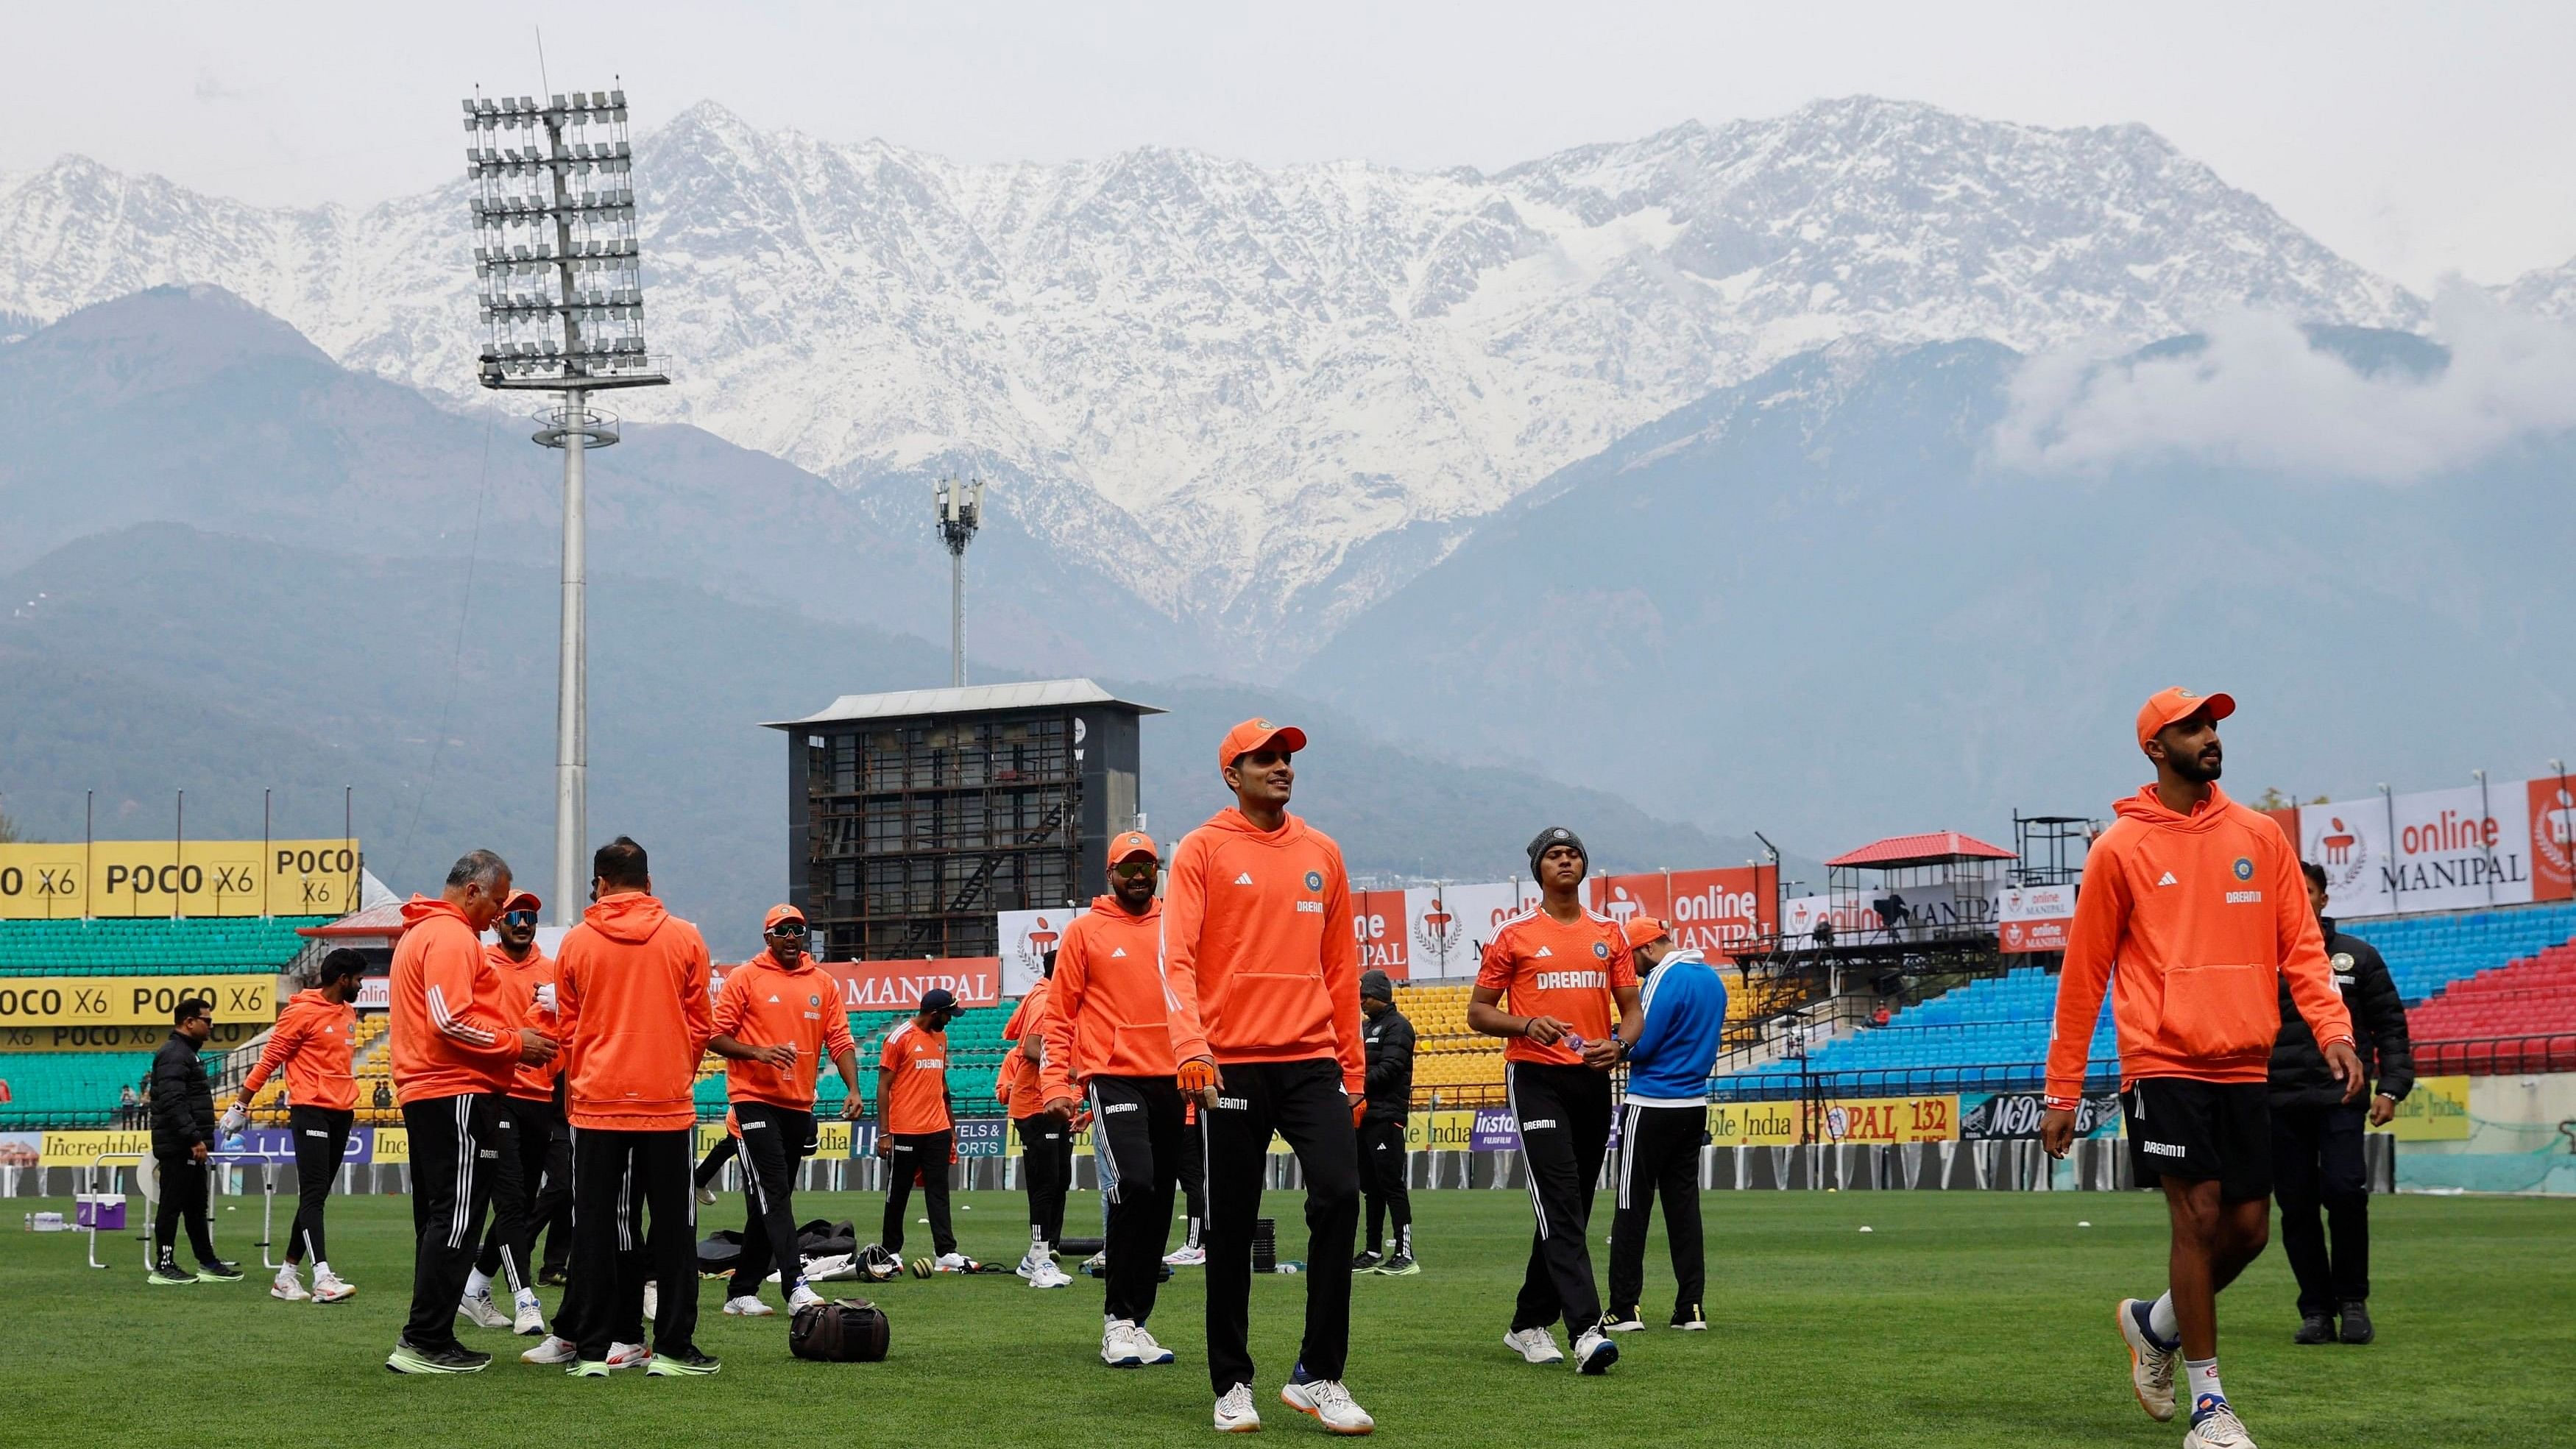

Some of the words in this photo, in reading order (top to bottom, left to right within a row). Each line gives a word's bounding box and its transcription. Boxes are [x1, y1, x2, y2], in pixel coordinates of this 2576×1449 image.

[2403, 809, 2499, 854] online
[277, 849, 354, 874] POCO
[38, 868, 75, 894] X6
[107, 865, 202, 893] POCO
[217, 866, 253, 893] X6
[2379, 854, 2527, 893] MANIPAL
[302, 882, 330, 902] X6
[1676, 885, 1756, 921] online
[1537, 971, 1607, 990] DREAM11
[74, 989, 107, 1013] X6
[230, 988, 262, 1011] X6
[54, 1026, 120, 1046] POCO
[1105, 1103, 1138, 1115] DREAM11
[1909, 1099, 1947, 1131] 132
[1523, 1119, 1556, 1132] DREAM11
[1483, 1136, 1512, 1144] FUJIFILM
[2143, 1141, 2185, 1158] DREAM11
